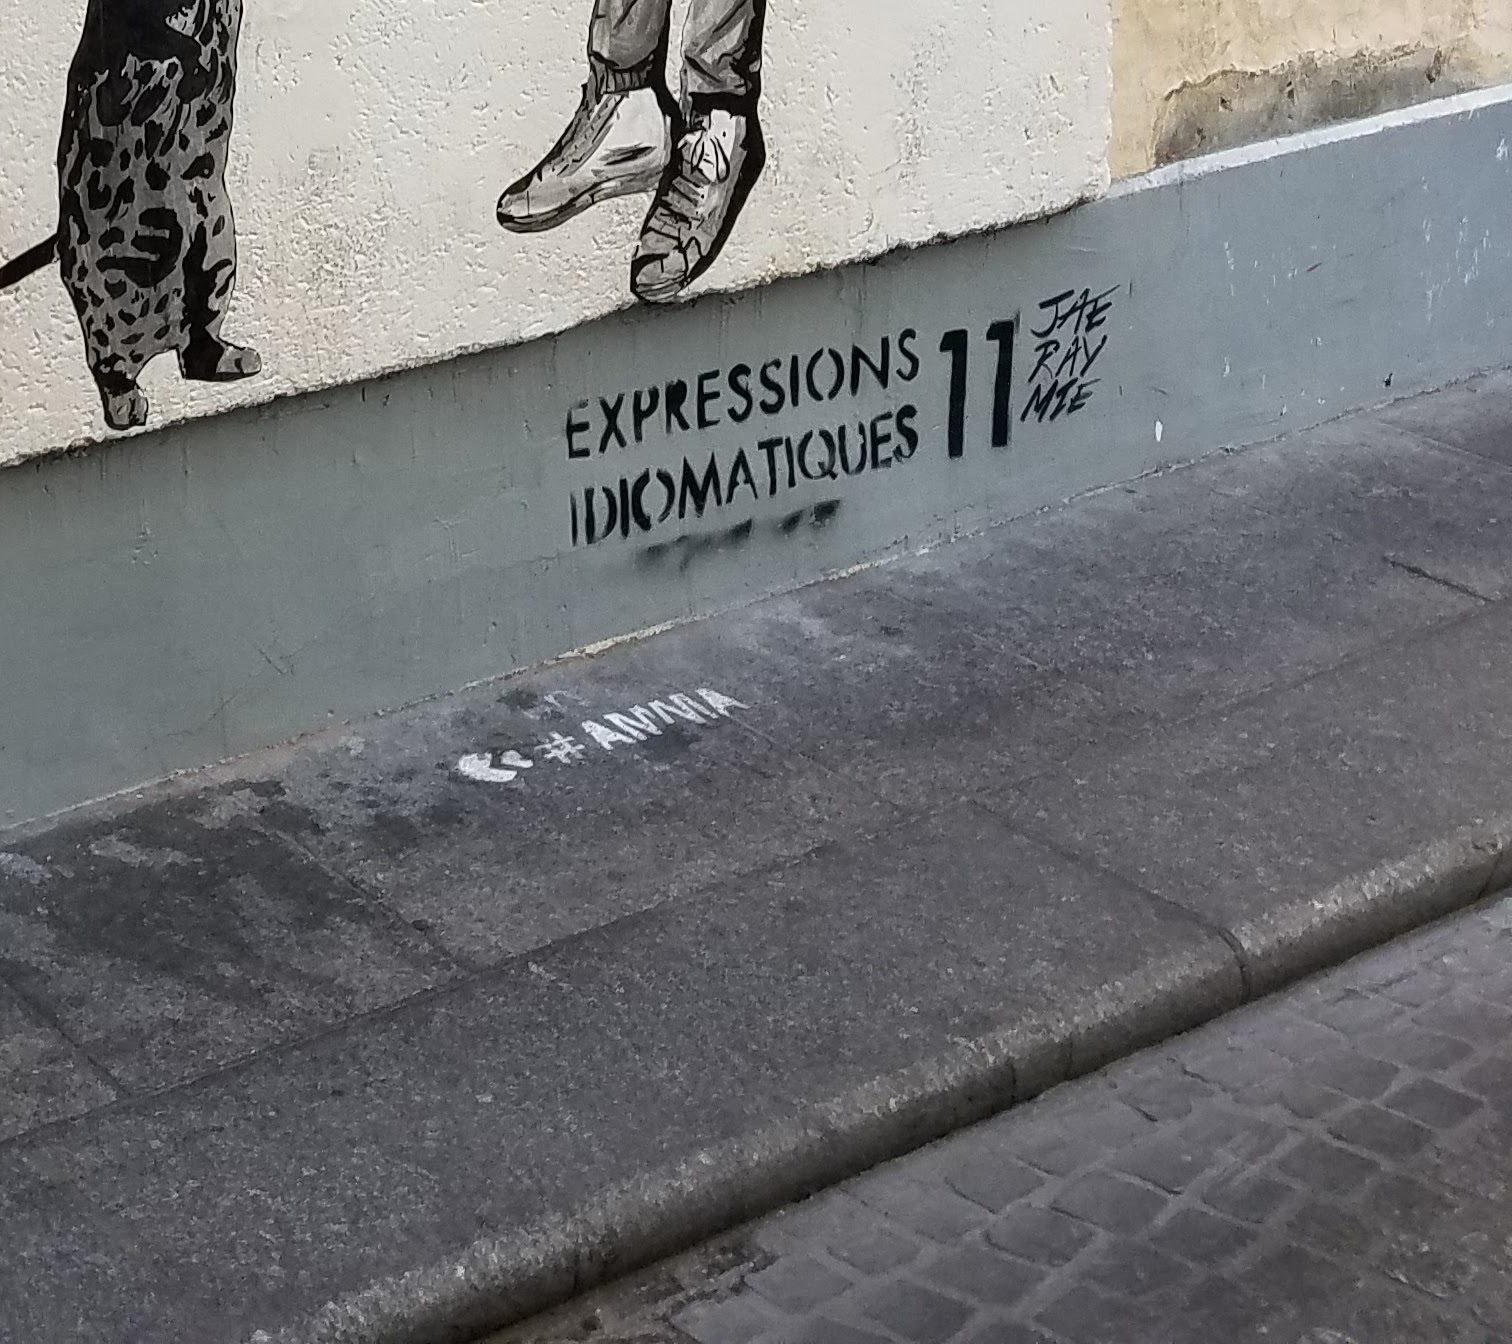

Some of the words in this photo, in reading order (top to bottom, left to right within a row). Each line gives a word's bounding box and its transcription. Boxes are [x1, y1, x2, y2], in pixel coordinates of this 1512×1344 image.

[565, 328, 920, 459] EXPRESSIONS
[939, 319, 1014, 459] 11
[1028, 334, 1108, 384] RAY
[569, 404, 919, 547] IDIOMATIQUES
